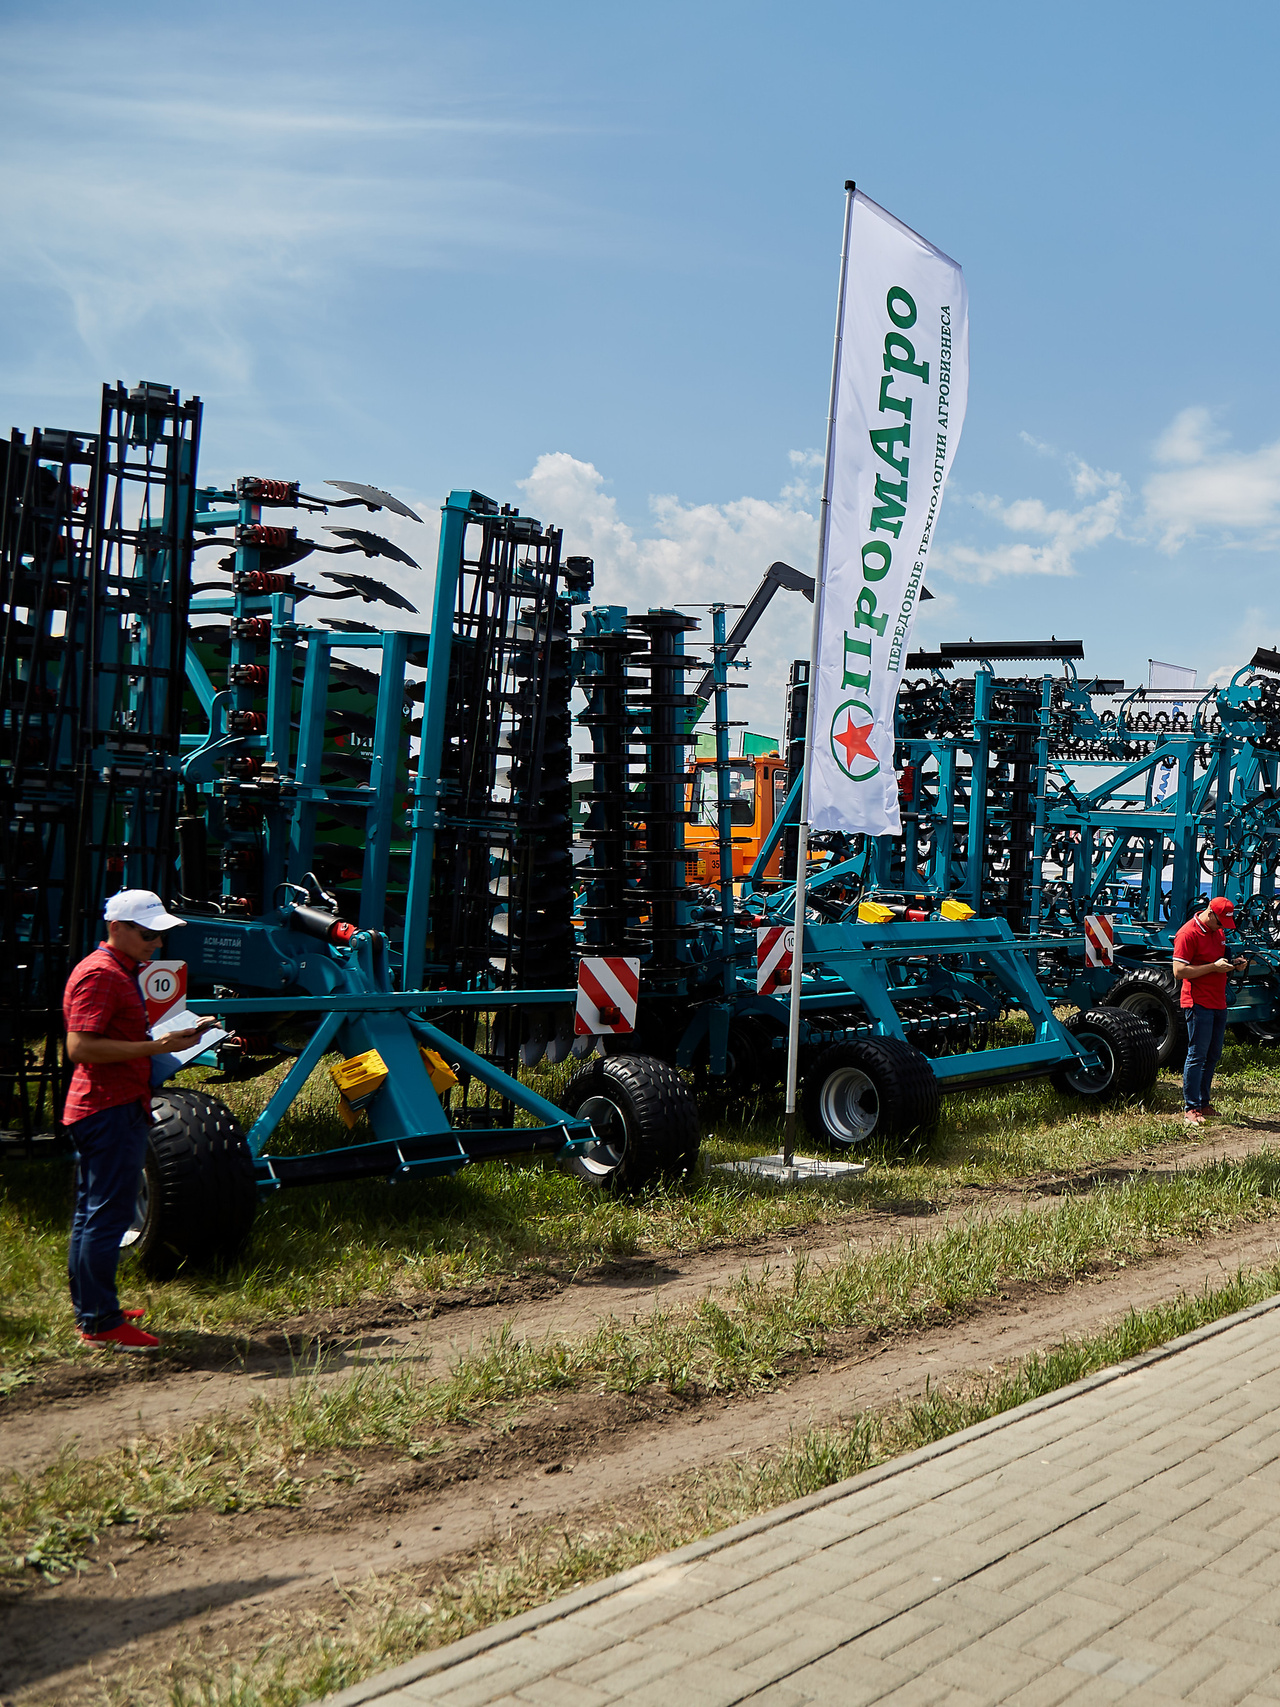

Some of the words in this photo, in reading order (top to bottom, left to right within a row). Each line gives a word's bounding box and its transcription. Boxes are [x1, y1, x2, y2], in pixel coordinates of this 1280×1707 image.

[887, 560, 924, 673] ПЕРЕДОВЫЕ
[918, 432, 947, 555] ТЕХНОЛОГИИ
[938, 304, 952, 430] АГРОБИЗНЕСА
[154, 978, 171, 993] 10
